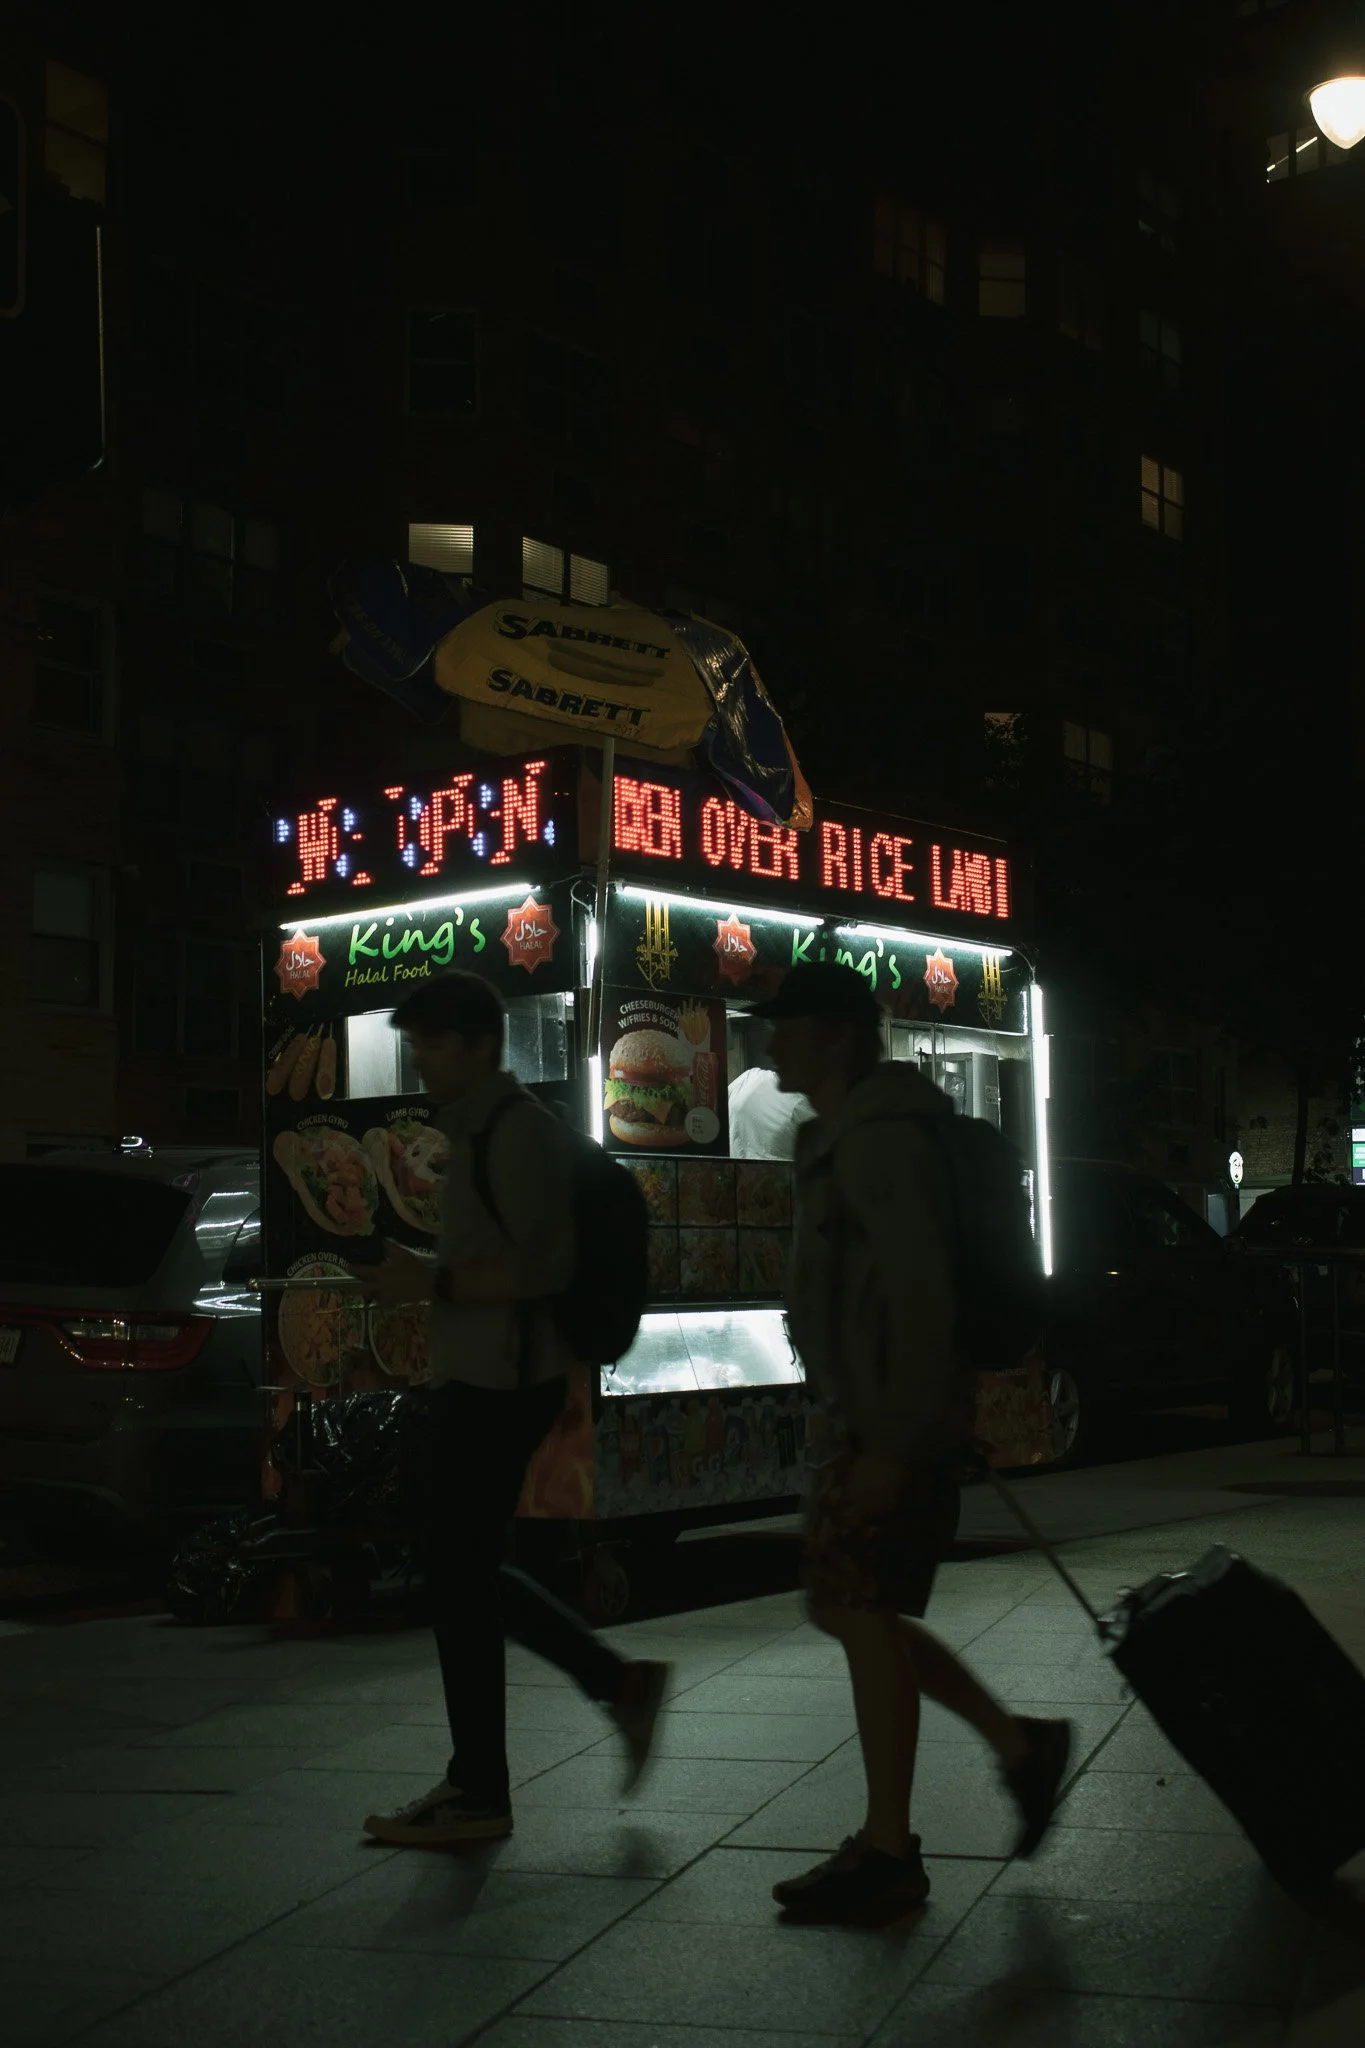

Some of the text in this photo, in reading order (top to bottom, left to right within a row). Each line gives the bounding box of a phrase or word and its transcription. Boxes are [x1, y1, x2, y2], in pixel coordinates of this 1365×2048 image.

[494, 608, 669, 660] SABRETT
[486, 665, 651, 725] SABRETT
[821, 820, 914, 901] RICE
[347, 905, 487, 966] King's
[514, 919, 548, 943] حلال
[723, 931, 748, 954] حلال
[519, 941, 543, 951] HALAL
[286, 949, 315, 972] حلال
[289, 969, 311, 980] HALAL
[344, 959, 432, 988] Halal Food
[931, 965, 952, 986] حلال
[617, 1012, 651, 1030] W/FRIES
[619, 999, 680, 1021] CHEESEBURGER
[297, 1113, 349, 1130] CHICKEN GYRO
[385, 1106, 430, 1122] LAMB GYRO
[286, 1254, 318, 1277] CHICKEN
[317, 1251, 338, 1263] OVER
